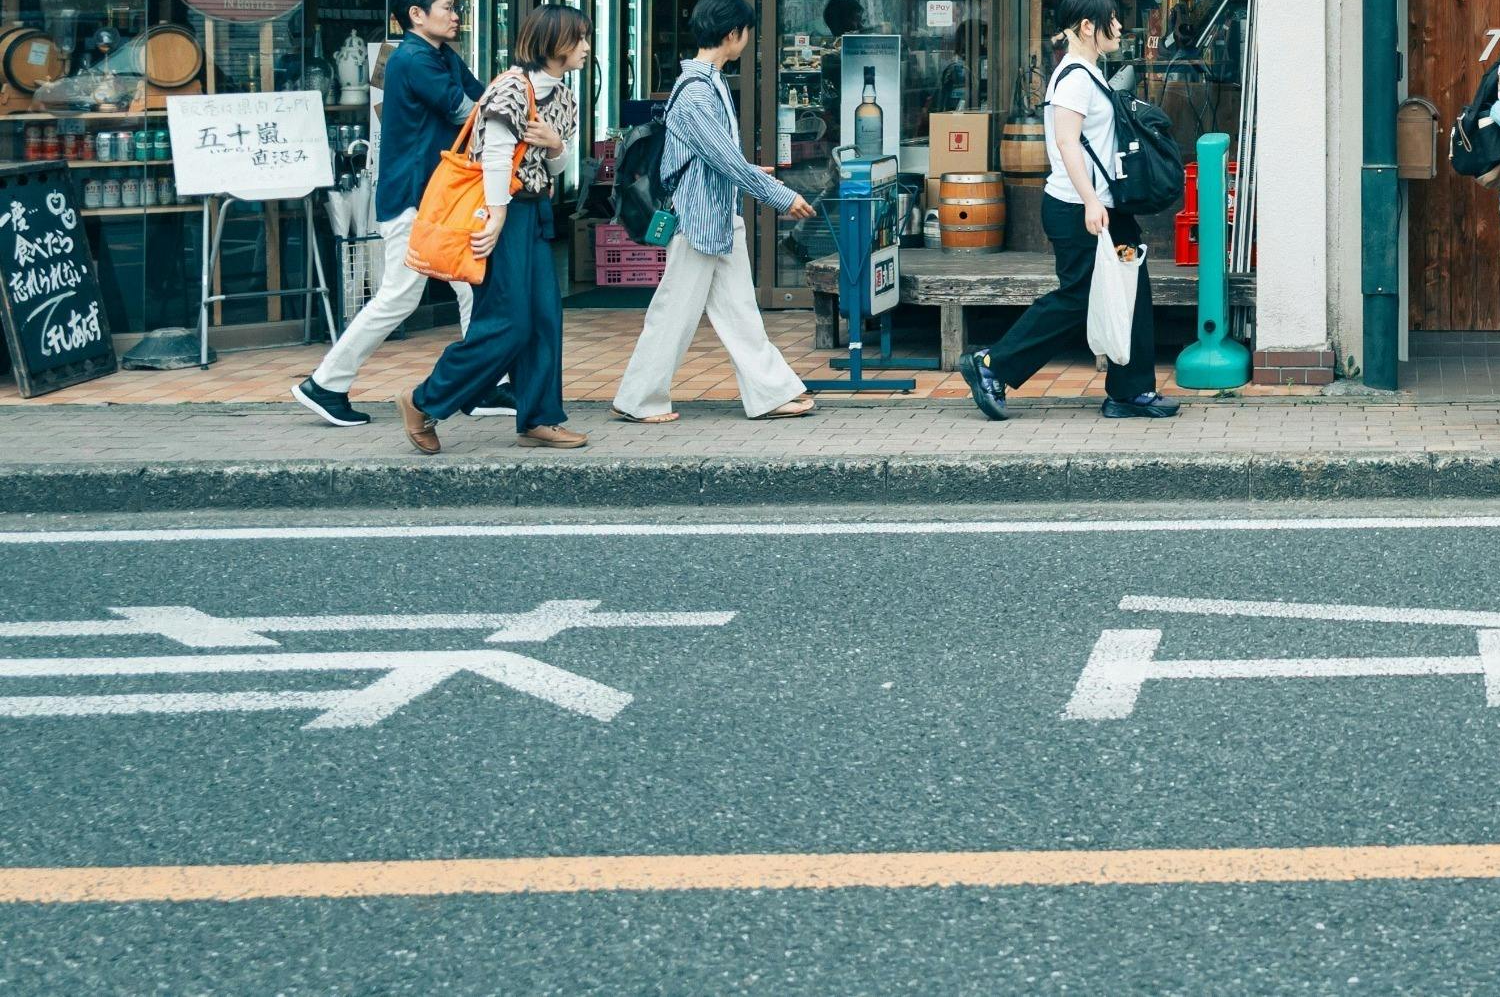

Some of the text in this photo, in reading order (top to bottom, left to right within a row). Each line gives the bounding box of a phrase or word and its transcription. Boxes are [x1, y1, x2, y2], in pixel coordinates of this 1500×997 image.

[194, 121, 288, 151] 五十嵐
[14, 230, 75, 267] 食べたら
[9, 259, 88, 303] 忘れられない
